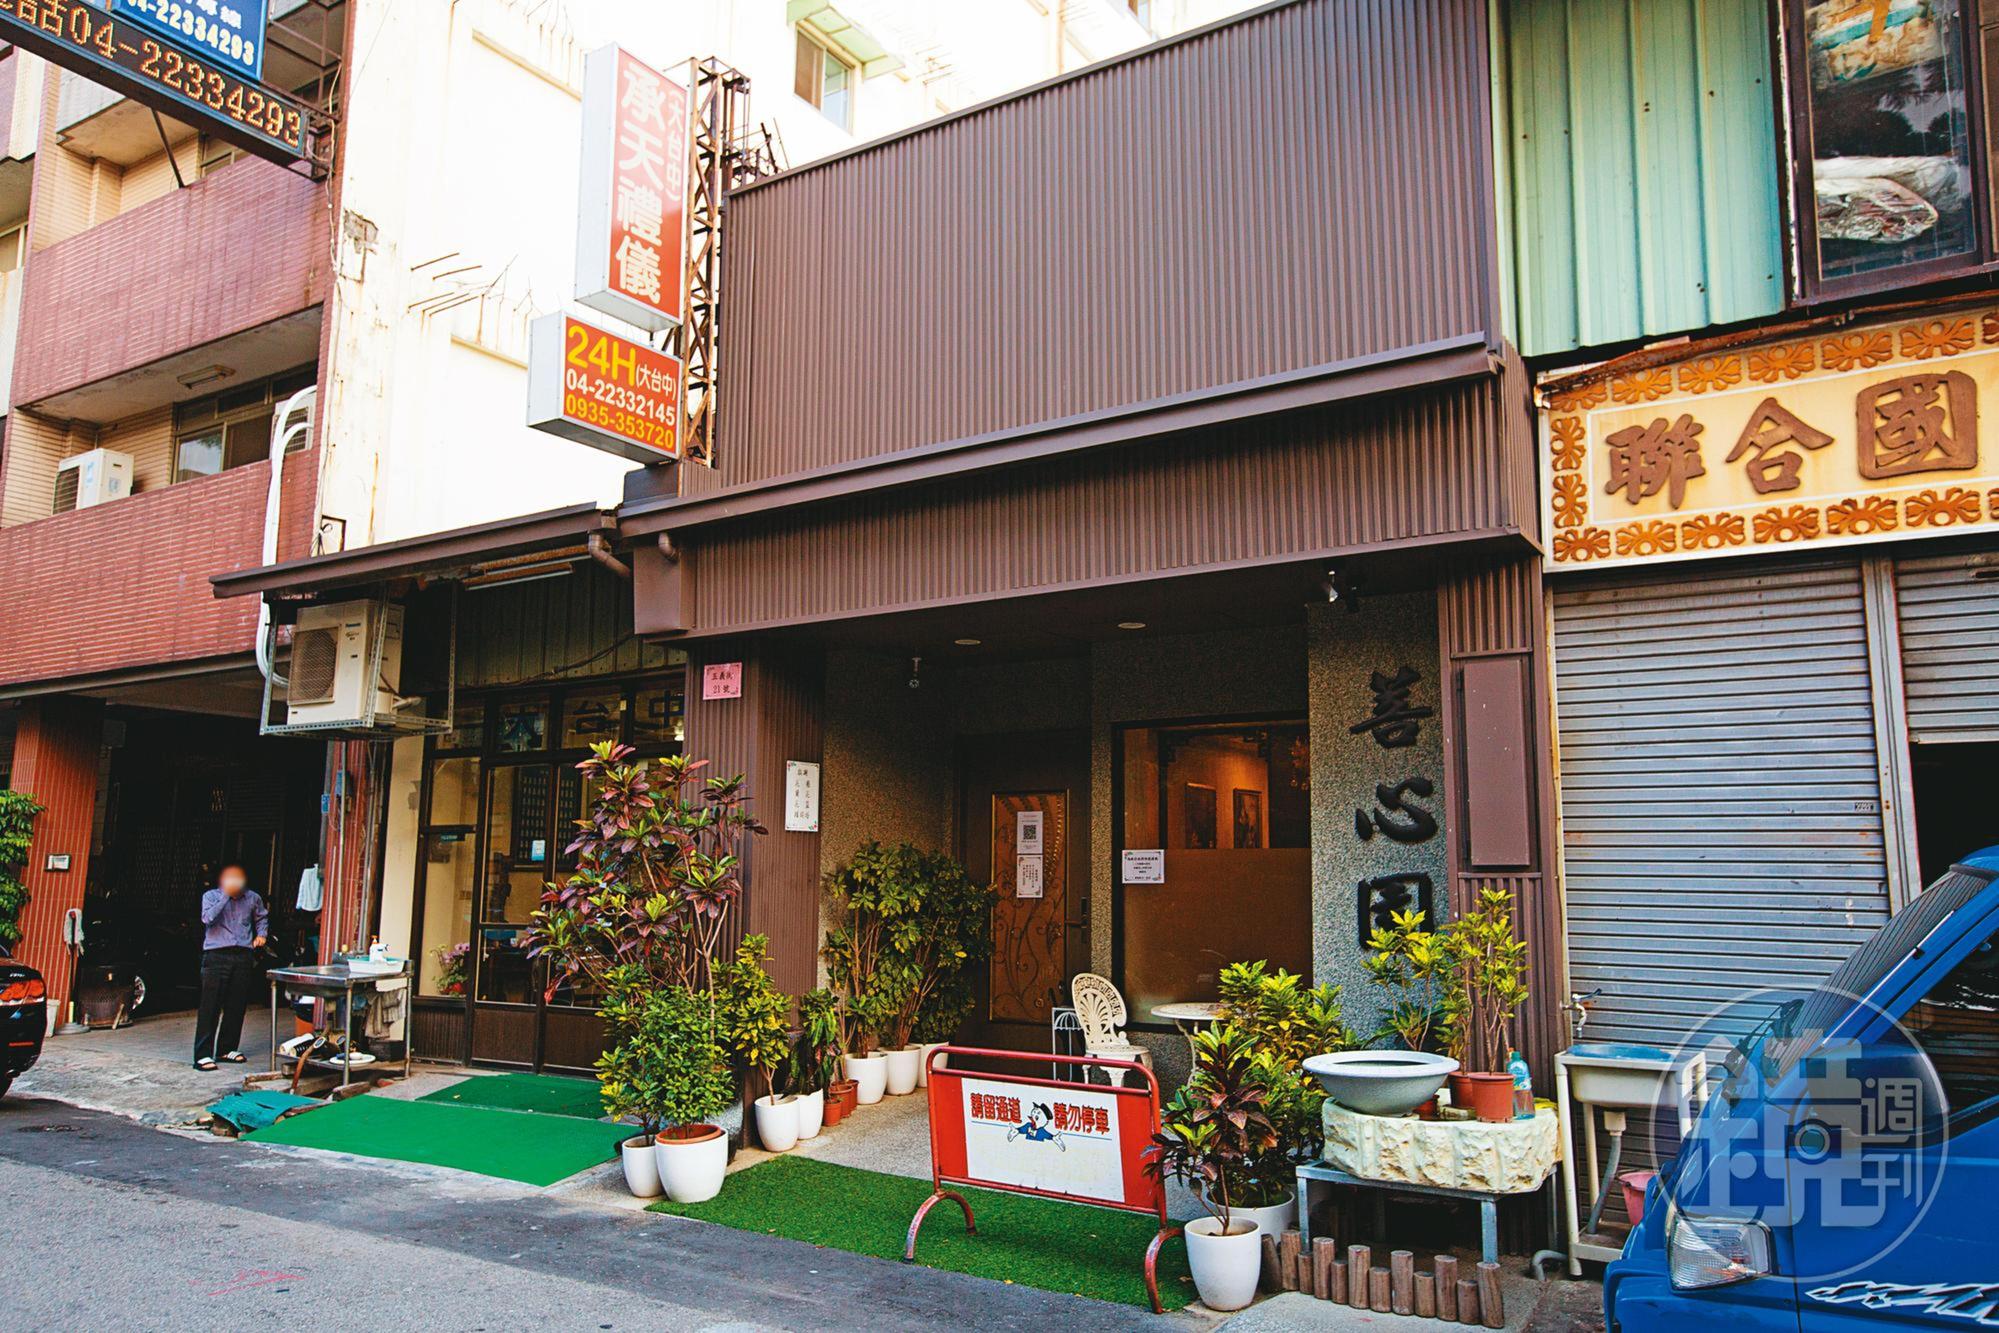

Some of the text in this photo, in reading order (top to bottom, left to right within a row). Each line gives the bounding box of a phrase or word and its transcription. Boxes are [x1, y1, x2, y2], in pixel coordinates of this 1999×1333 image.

[127, 0, 255, 66] 4-22334293
[665, 88, 683, 202] (大台中)
[615, 60, 666, 305] 承天禮儀
[566, 368, 675, 426] 04-22332145
[567, 325, 677, 401] 24H (大台中)
[565, 393, 674, 449] 0935-353720
[1605, 369, 1979, 511] 聯合國
[970, 1092, 1110, 1135] 請留通道 請勿停車
